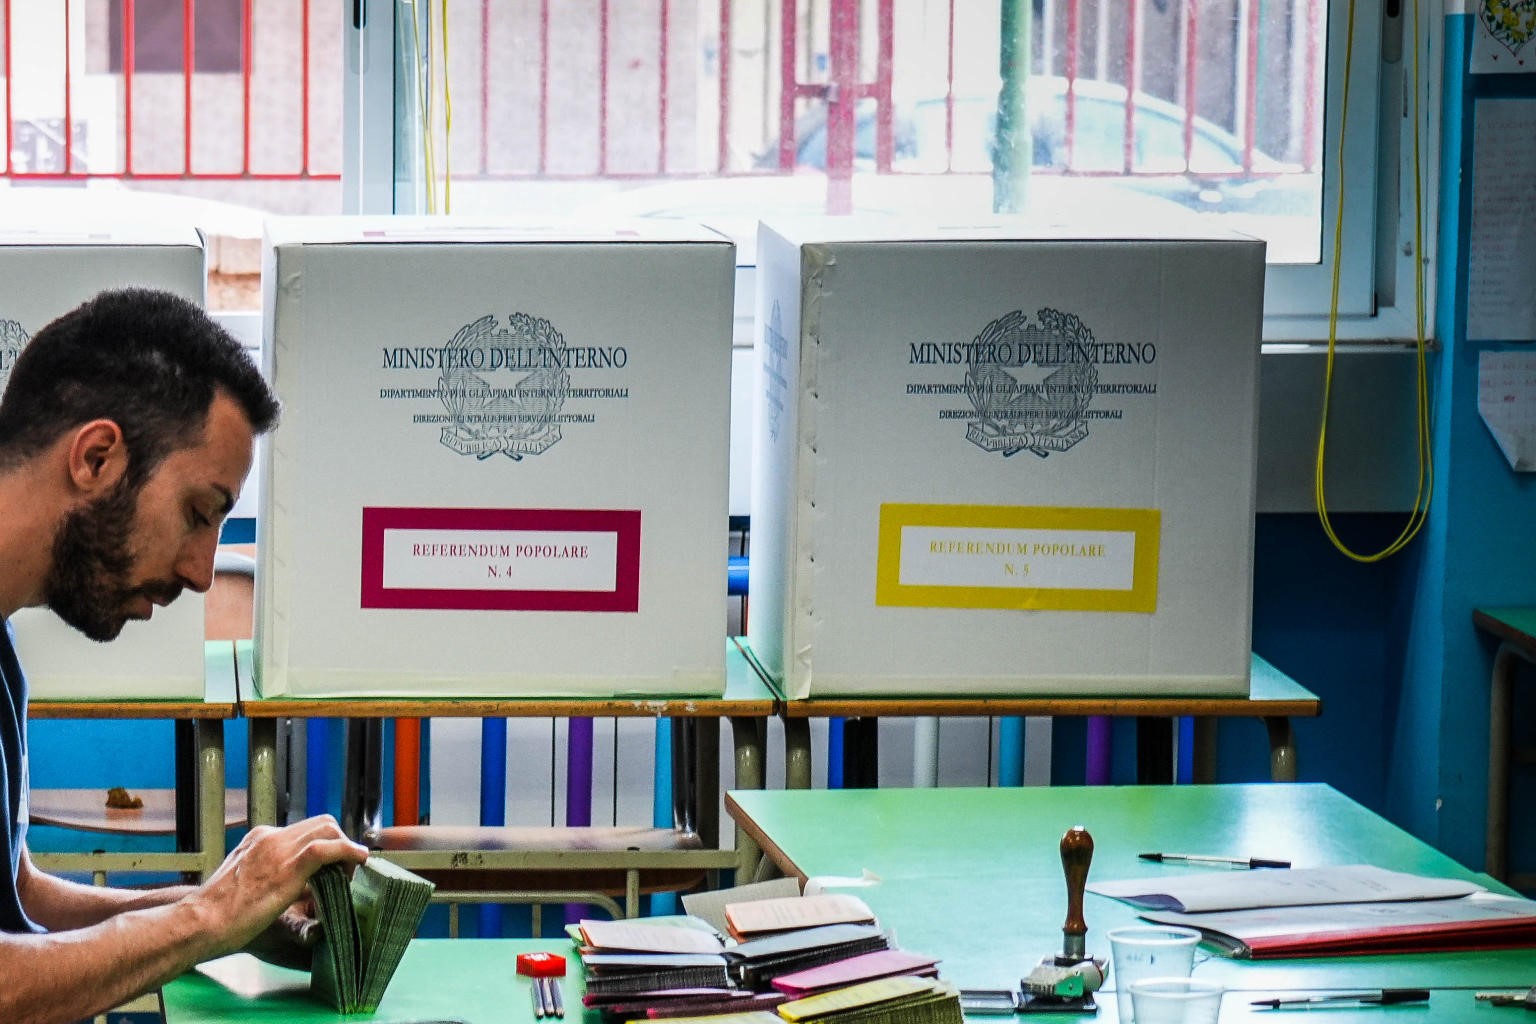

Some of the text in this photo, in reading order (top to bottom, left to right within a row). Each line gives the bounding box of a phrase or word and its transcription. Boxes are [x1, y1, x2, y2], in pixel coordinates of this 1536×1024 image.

[383, 347, 628, 369] MINISTERO DELL'INTERNO
[909, 342, 1156, 364] MINISTERO DELL'INTERNO
[568, 389, 629, 399] TERRITORIALI
[1095, 384, 1156, 394] TERRITORIALI
[413, 543, 588, 559] REFERENDUM POPOLARE
[929, 541, 1105, 557] REFERENDUM POPOLARE
[487, 565, 512, 578] N. 4
[1004, 563, 1018, 577] N.
